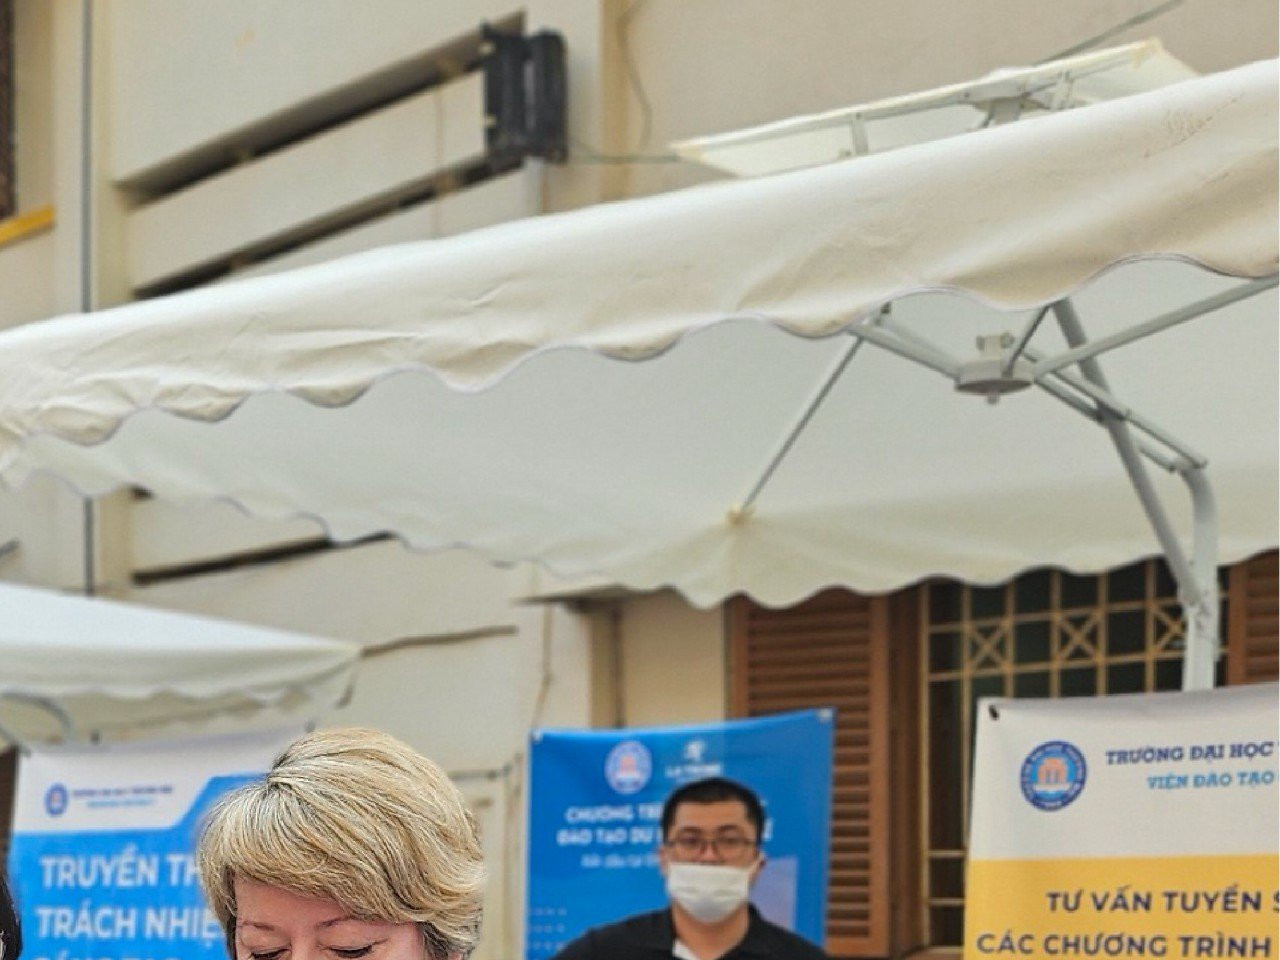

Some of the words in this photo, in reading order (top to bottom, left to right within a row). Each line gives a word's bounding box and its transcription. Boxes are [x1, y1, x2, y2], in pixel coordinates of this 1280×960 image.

[1047, 889, 1085, 913] TƯ
[1091, 884, 1152, 913] VẤN
[36, 901, 136, 939] TRÁCH
[976, 929, 1035, 955] CÁC
[1043, 933, 1167, 957] CHƯƠNG
[1178, 930, 1272, 958] TRÌNH
